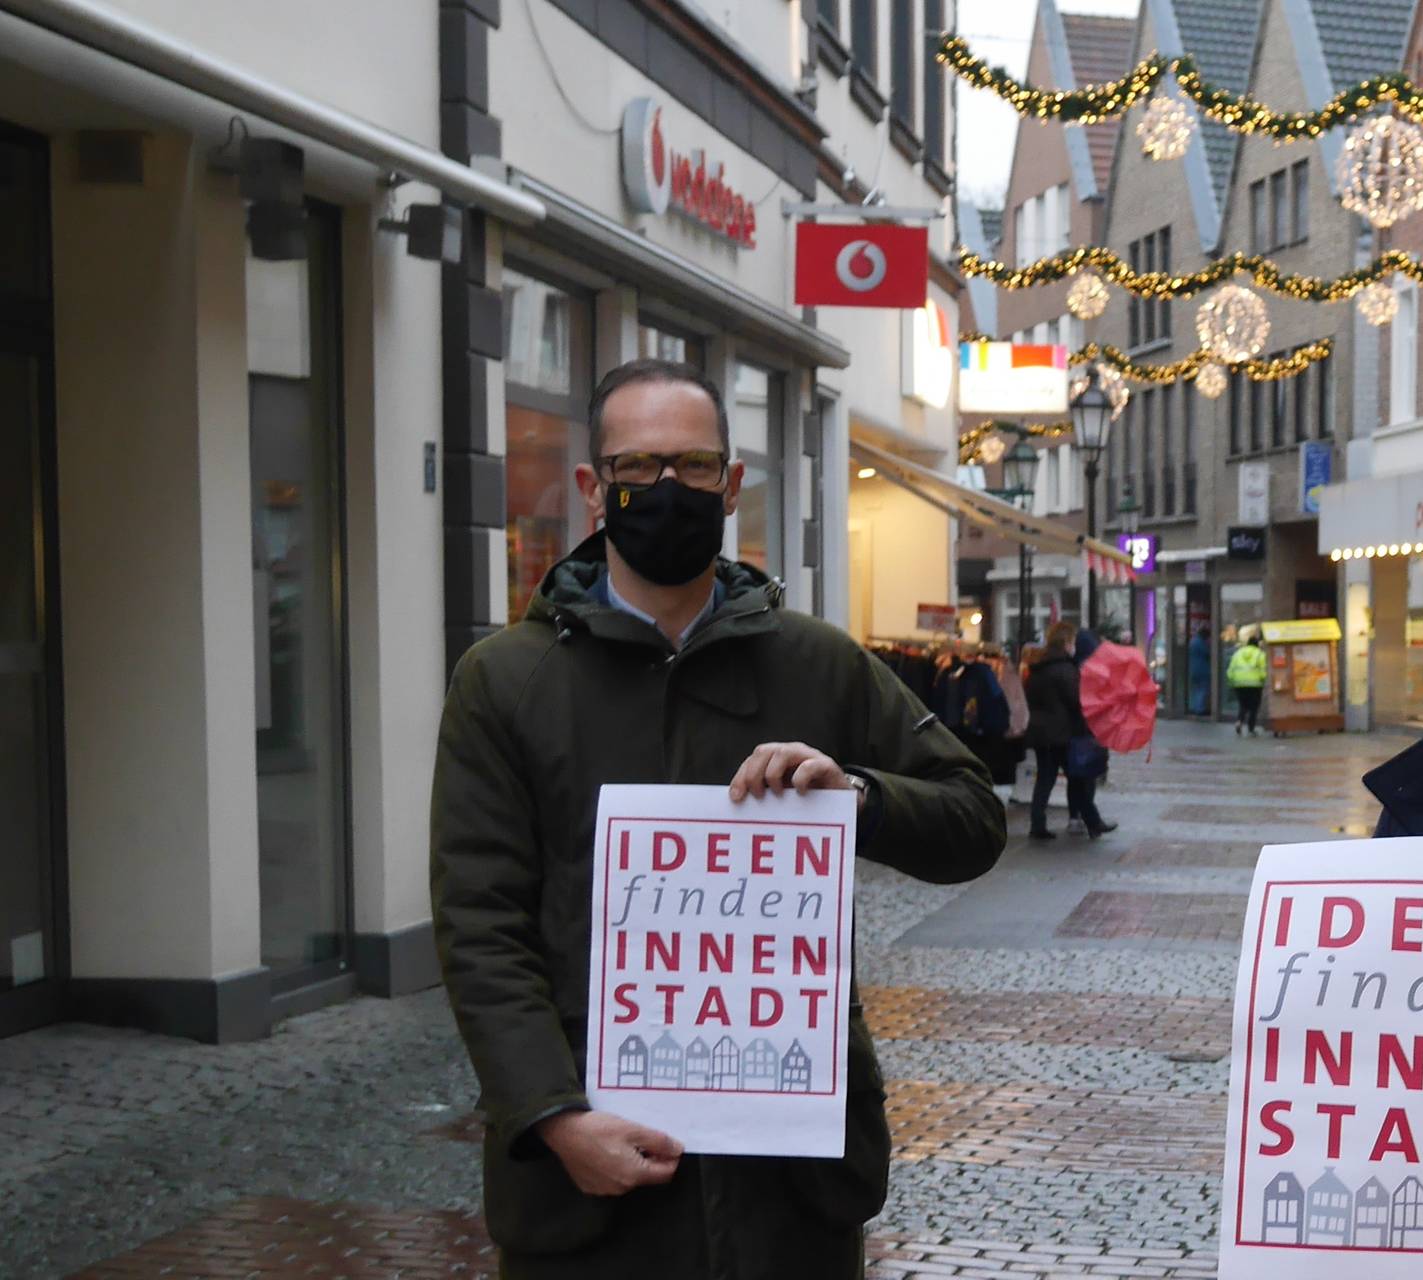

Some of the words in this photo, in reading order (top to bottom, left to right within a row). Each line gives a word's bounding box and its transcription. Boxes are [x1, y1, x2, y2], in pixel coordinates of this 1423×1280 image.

[669, 148, 756, 250] vodafone
[1231, 534, 1260, 553] sky
[619, 830, 831, 876] IDEEN
[612, 874, 823, 926] finden
[616, 930, 827, 976] INNEN
[613, 983, 828, 1029] STADT
